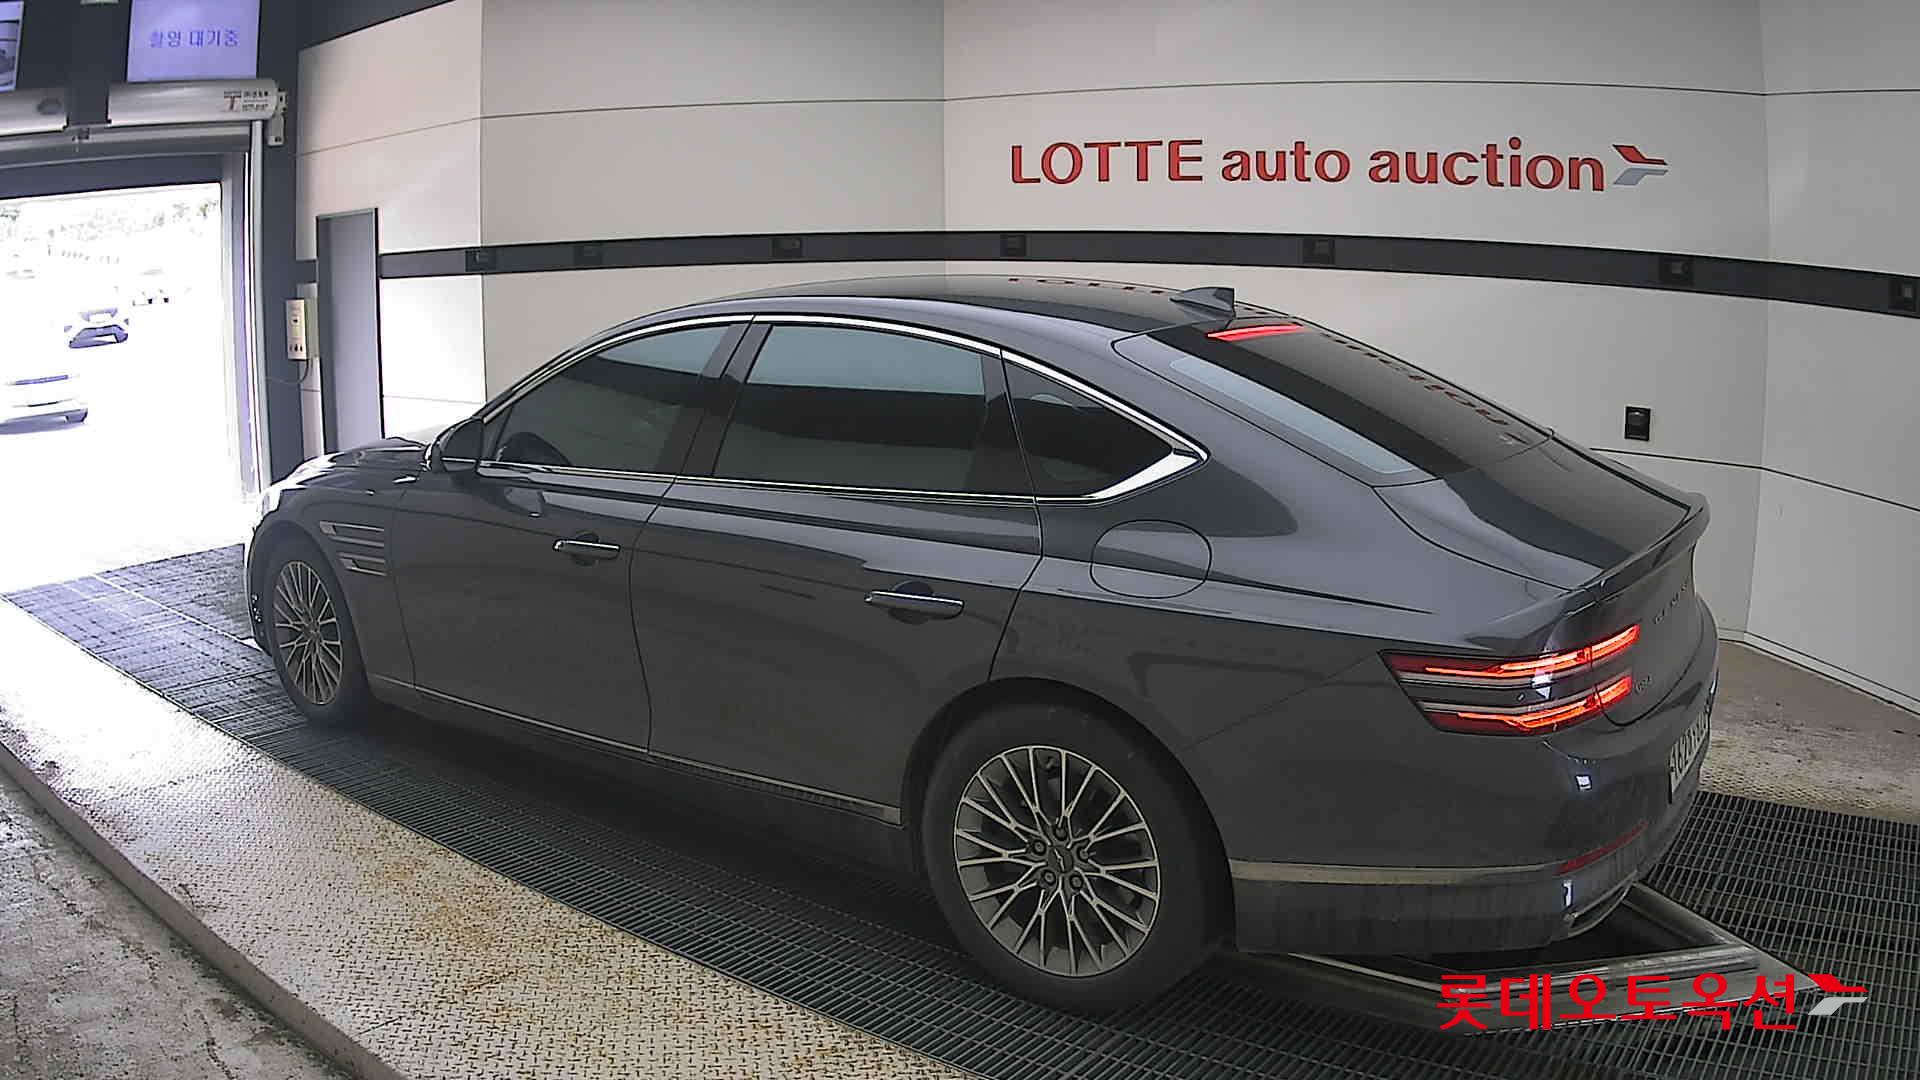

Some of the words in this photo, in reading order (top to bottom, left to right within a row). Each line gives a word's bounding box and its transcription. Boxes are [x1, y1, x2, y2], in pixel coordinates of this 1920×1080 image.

[189, 29, 239, 48] 대기중
[1011, 139, 1203, 185] LOTTE
[1221, 141, 1351, 183] auto
[1368, 136, 1605, 192] auction
